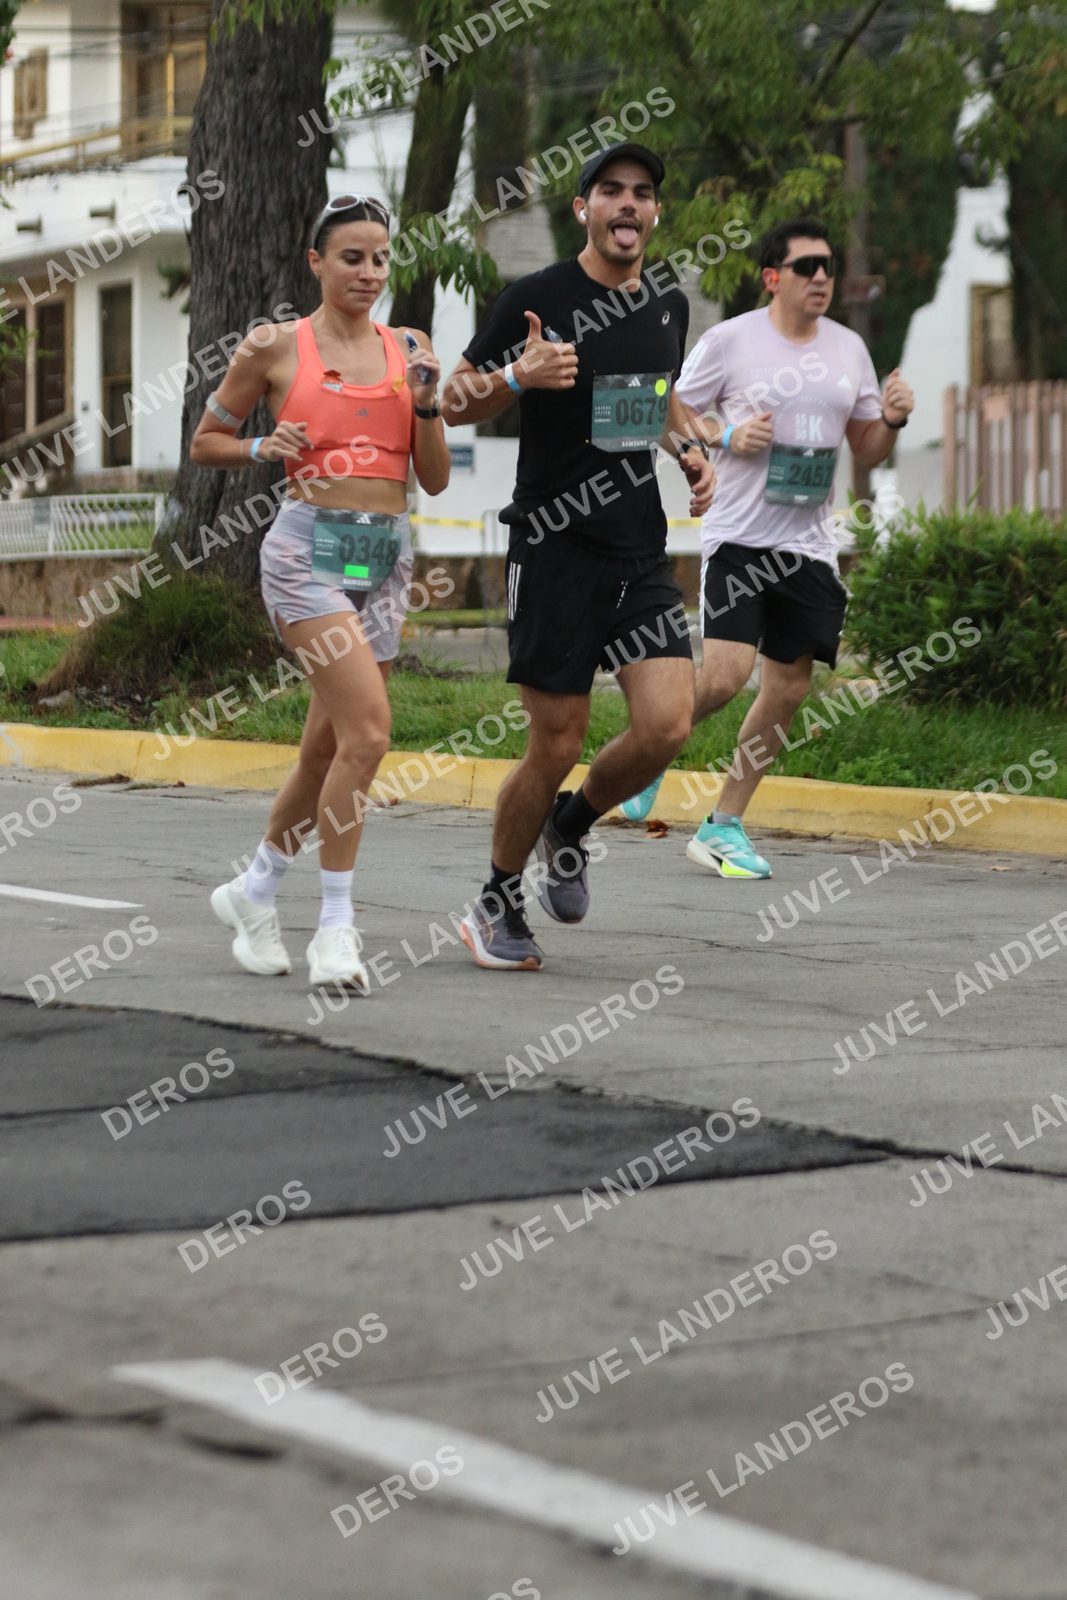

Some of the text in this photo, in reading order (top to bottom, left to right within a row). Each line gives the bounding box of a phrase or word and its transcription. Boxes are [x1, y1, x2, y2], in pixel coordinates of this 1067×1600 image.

[615, 396, 668, 426] 0679
[787, 463, 835, 488] 2457
[338, 534, 399, 567] 0348
